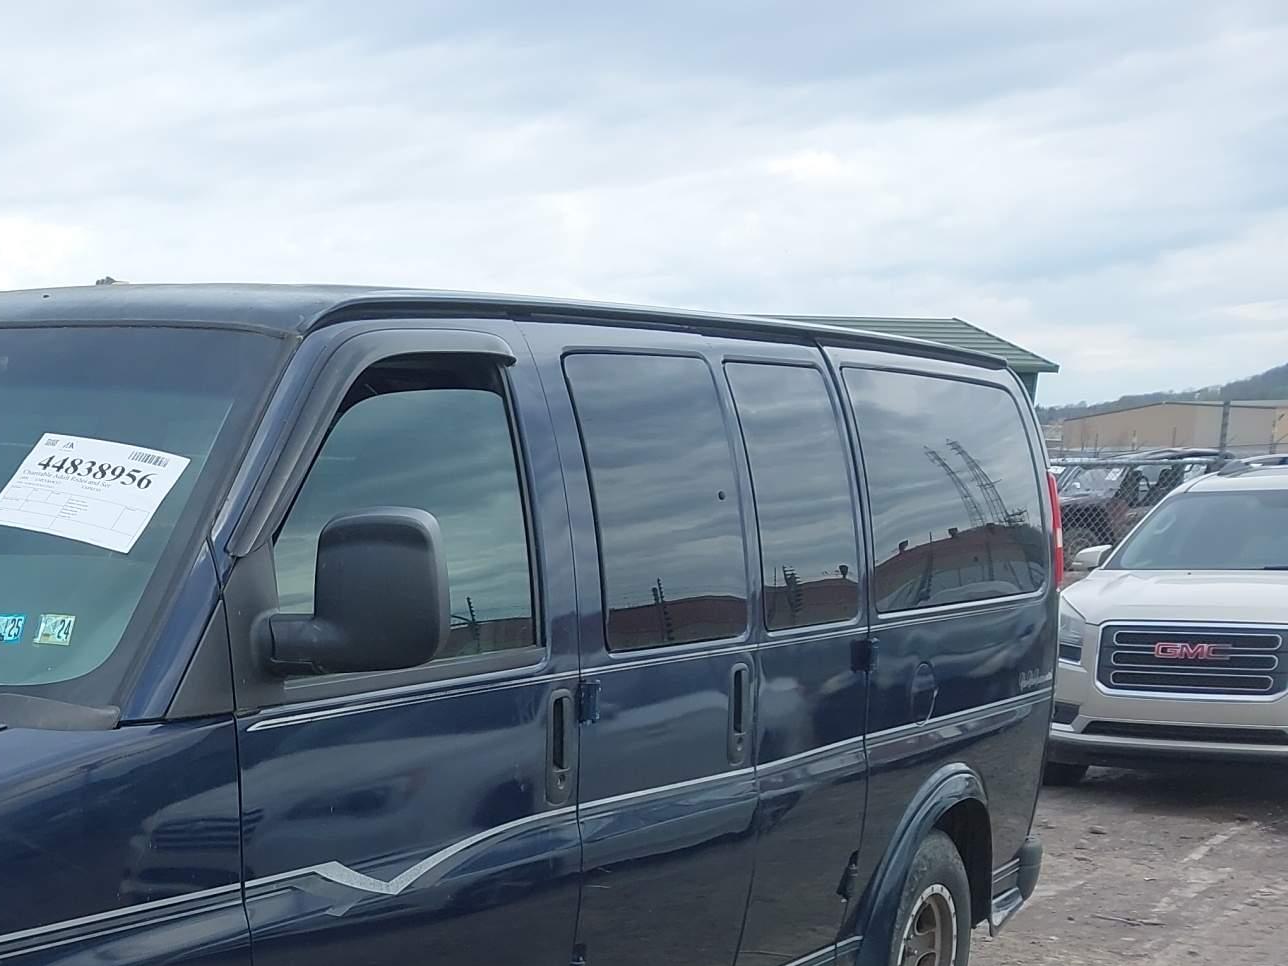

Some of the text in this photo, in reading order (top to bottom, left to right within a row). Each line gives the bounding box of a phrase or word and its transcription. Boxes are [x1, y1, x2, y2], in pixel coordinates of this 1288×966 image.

[37, 454, 158, 490] 44838956
[57, 619, 72, 640] 24
[1154, 641, 1233, 661] GMC
